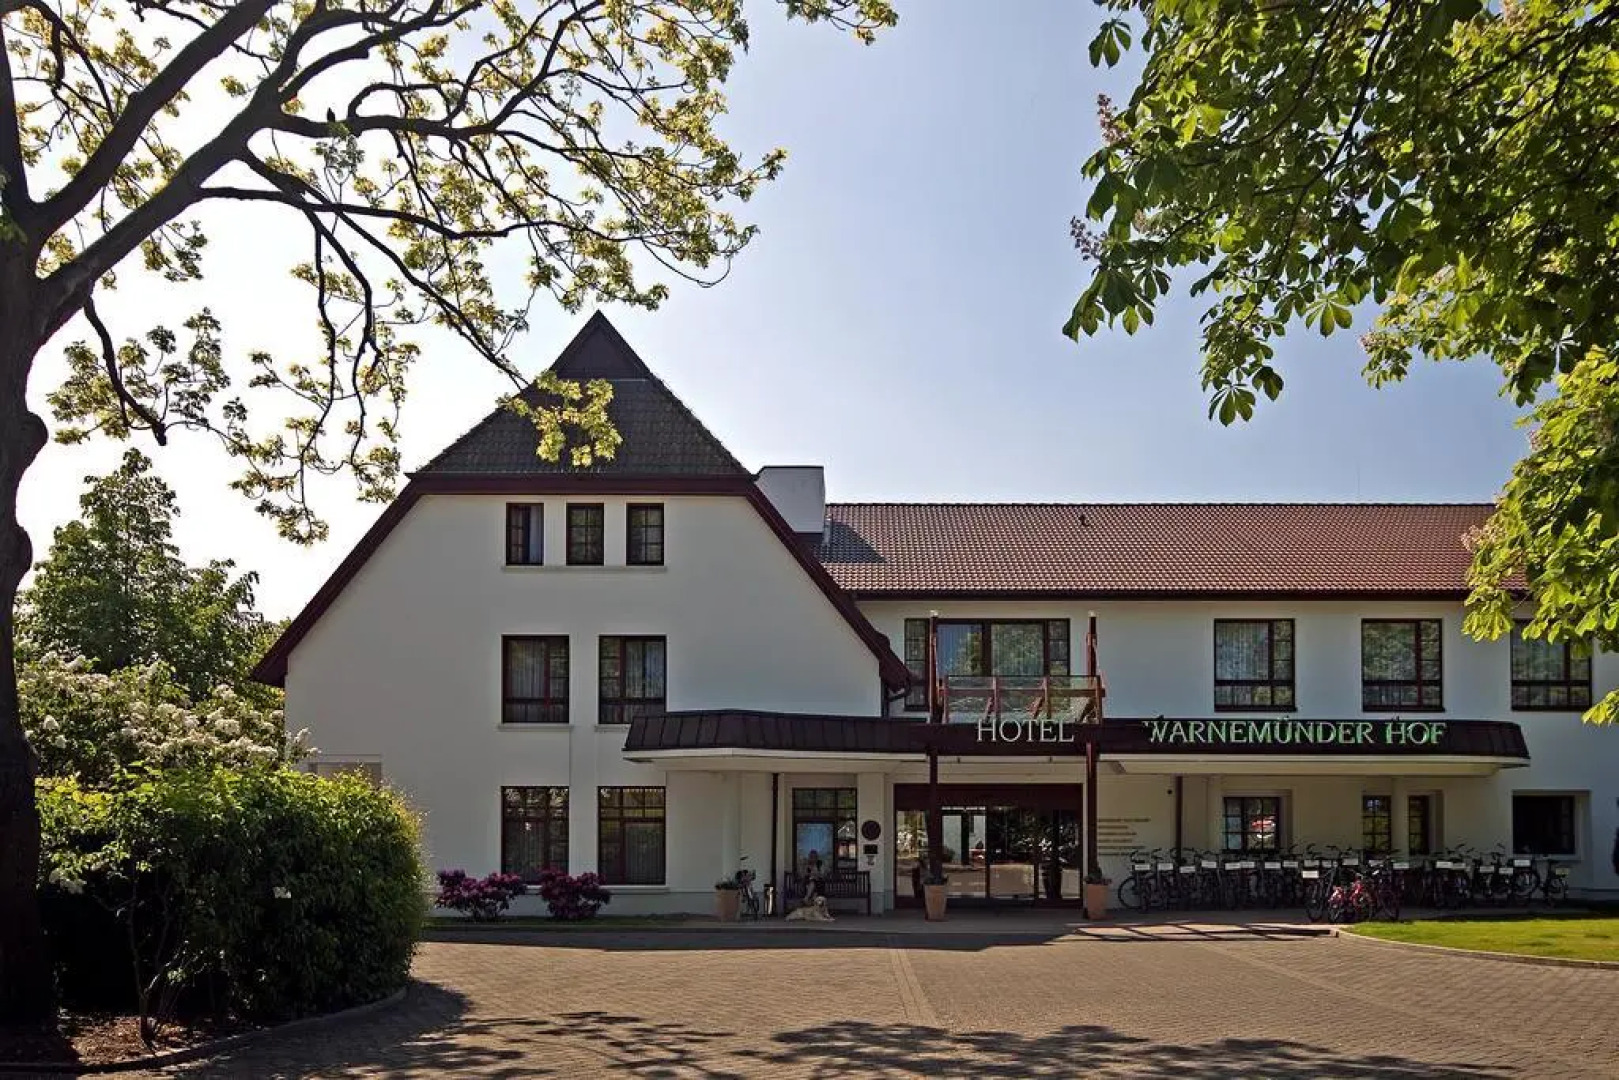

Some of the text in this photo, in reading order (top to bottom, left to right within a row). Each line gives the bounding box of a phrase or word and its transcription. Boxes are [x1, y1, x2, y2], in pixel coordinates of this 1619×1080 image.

[976, 716, 1446, 745] HOTEL WARNEMÜNDER HOF
